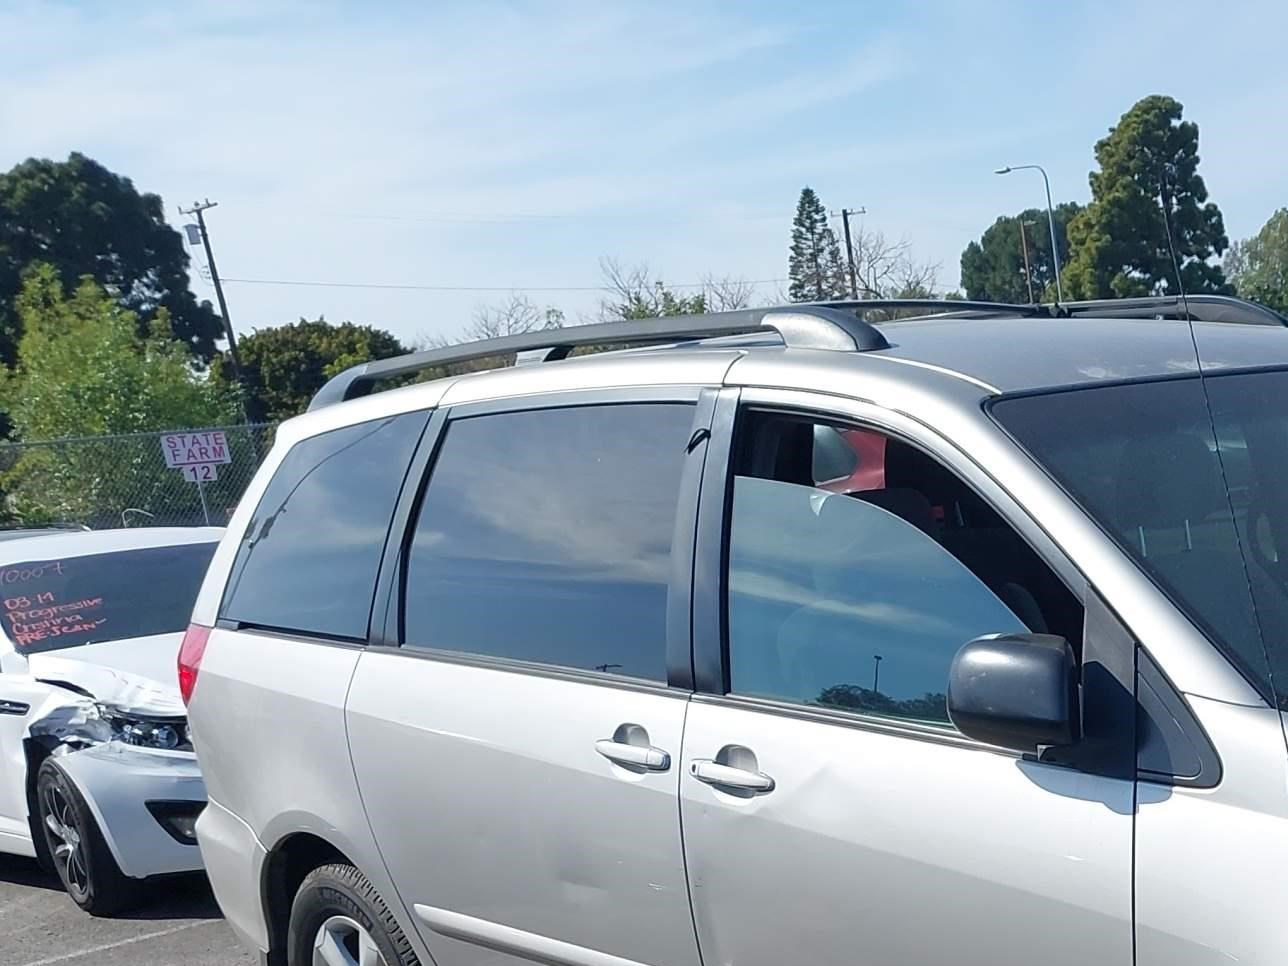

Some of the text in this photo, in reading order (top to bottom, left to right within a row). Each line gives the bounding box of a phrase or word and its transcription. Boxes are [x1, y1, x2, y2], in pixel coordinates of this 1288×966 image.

[166, 432, 225, 449] STATE
[171, 446, 225, 462] FARM
[190, 465, 212, 481] 12
